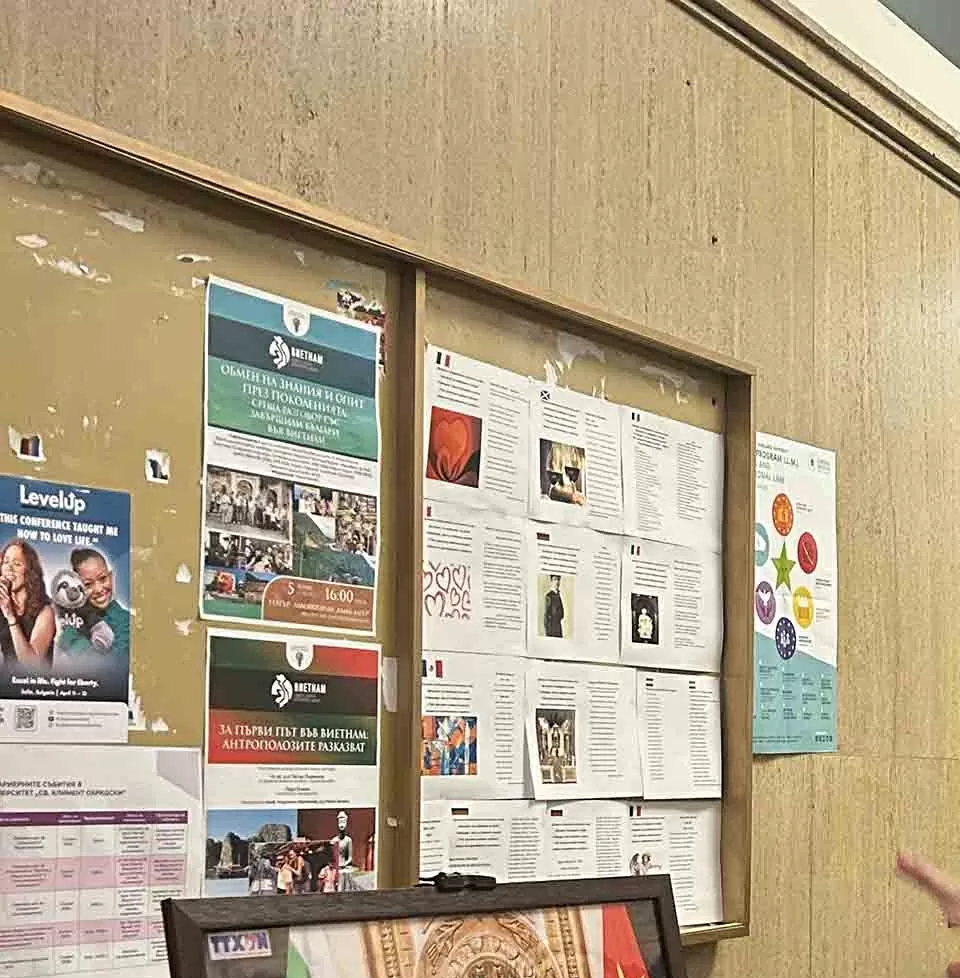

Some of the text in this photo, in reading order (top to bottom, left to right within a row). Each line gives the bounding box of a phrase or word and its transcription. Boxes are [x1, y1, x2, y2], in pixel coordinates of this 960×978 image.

[220, 364, 260, 382] ОБМЕН
[279, 377, 323, 399] ЗНАНИЯ
[325, 389, 334, 401] И
[335, 391, 364, 409] ОПИТ
[242, 382, 270, 399] ПРЕЗ
[19, 484, 86, 515] LevelUp
[20, 515, 71, 531] CONFERENCE
[71, 521, 104, 535] TAUGHT
[106, 526, 119, 537] ME
[40, 531, 51, 542] TO
[52, 532, 74, 545] LOVE
[325, 586, 354, 603] 16:00
[294, 682, 327, 694] ВИЕТНАМ
[218, 724, 233, 736] ЗА
[235, 724, 273, 738] ПЪРВИ
[275, 725, 298, 738] ПЪТ
[300, 727, 319, 738] ВЪВ
[222, 739, 366, 752] АНТРОПОЛОЗИТЕ РАЗКАЗВАТ
